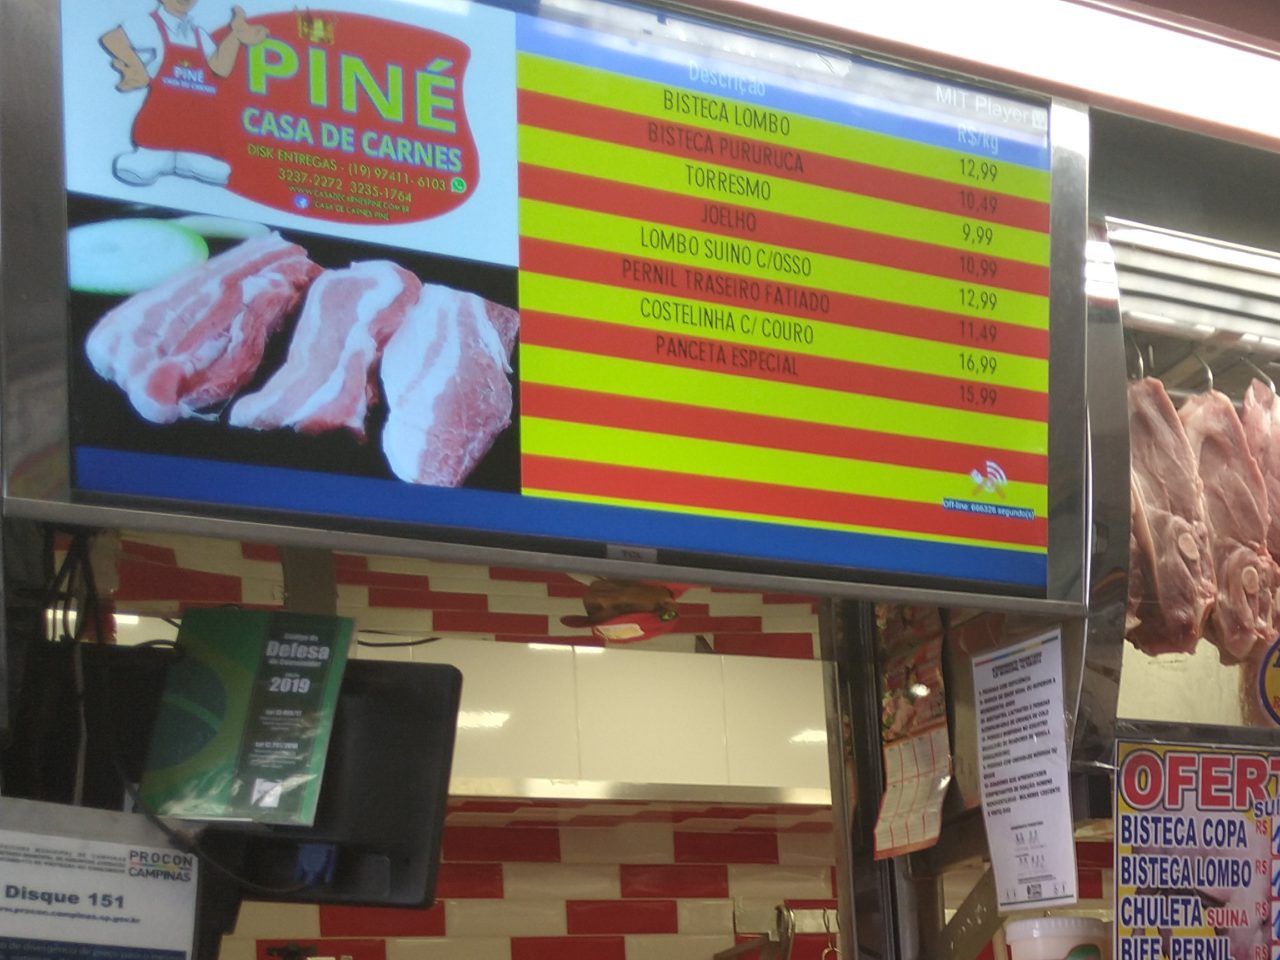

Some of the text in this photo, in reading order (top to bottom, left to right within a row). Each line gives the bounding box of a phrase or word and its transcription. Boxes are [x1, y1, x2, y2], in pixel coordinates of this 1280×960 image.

[246, 37, 459, 133] PINÉ
[689, 60, 767, 98] Descrição
[663, 88, 791, 137] BISTECA LOMBO
[936, 86, 1028, 124] MIT Player
[242, 107, 463, 173] CASA DE CARNES
[647, 120, 804, 175] BISTECA PURURUCA
[957, 123, 1000, 155] R$/kg
[247, 143, 274, 160] DISK
[277, 148, 338, 172] ENTREGAS
[349, 162, 371, 179] (19)
[417, 176, 446, 192] 6103
[685, 164, 771, 201] TORRESMO
[958, 157, 999, 184] 12,99
[701, 202, 757, 233] JOELHO
[958, 189, 998, 215] 10,49
[961, 223, 994, 247] 9,99
[640, 225, 812, 278] LOMBO SUINO C/OSSO
[958, 254, 998, 280] 10,99
[621, 258, 831, 314] PERNIL TRASEIRO FATIADO
[958, 288, 998, 312] 12,99
[639, 297, 815, 345] COSTELINHA C/ COURO
[958, 320, 998, 344] 11,49
[655, 335, 799, 377] PANCETA ESPECIAL
[958, 351, 998, 375] 16,99
[958, 384, 998, 407] 15,99
[265, 640, 330, 661] Defesa
[269, 676, 311, 694] 2019
[1120, 814, 1198, 847] BISTECA
[1202, 818, 1248, 849] COPA
[129, 849, 193, 867] PROCON
[129, 866, 191, 882] CAMPINAS
[1120, 855, 1195, 889] BISTECA
[1197, 857, 1251, 889] LOMBO
[5, 883, 125, 910] Disque 151
[1120, 896, 1202, 928] CHULETA
[1206, 906, 1249, 928] SUÍNA
